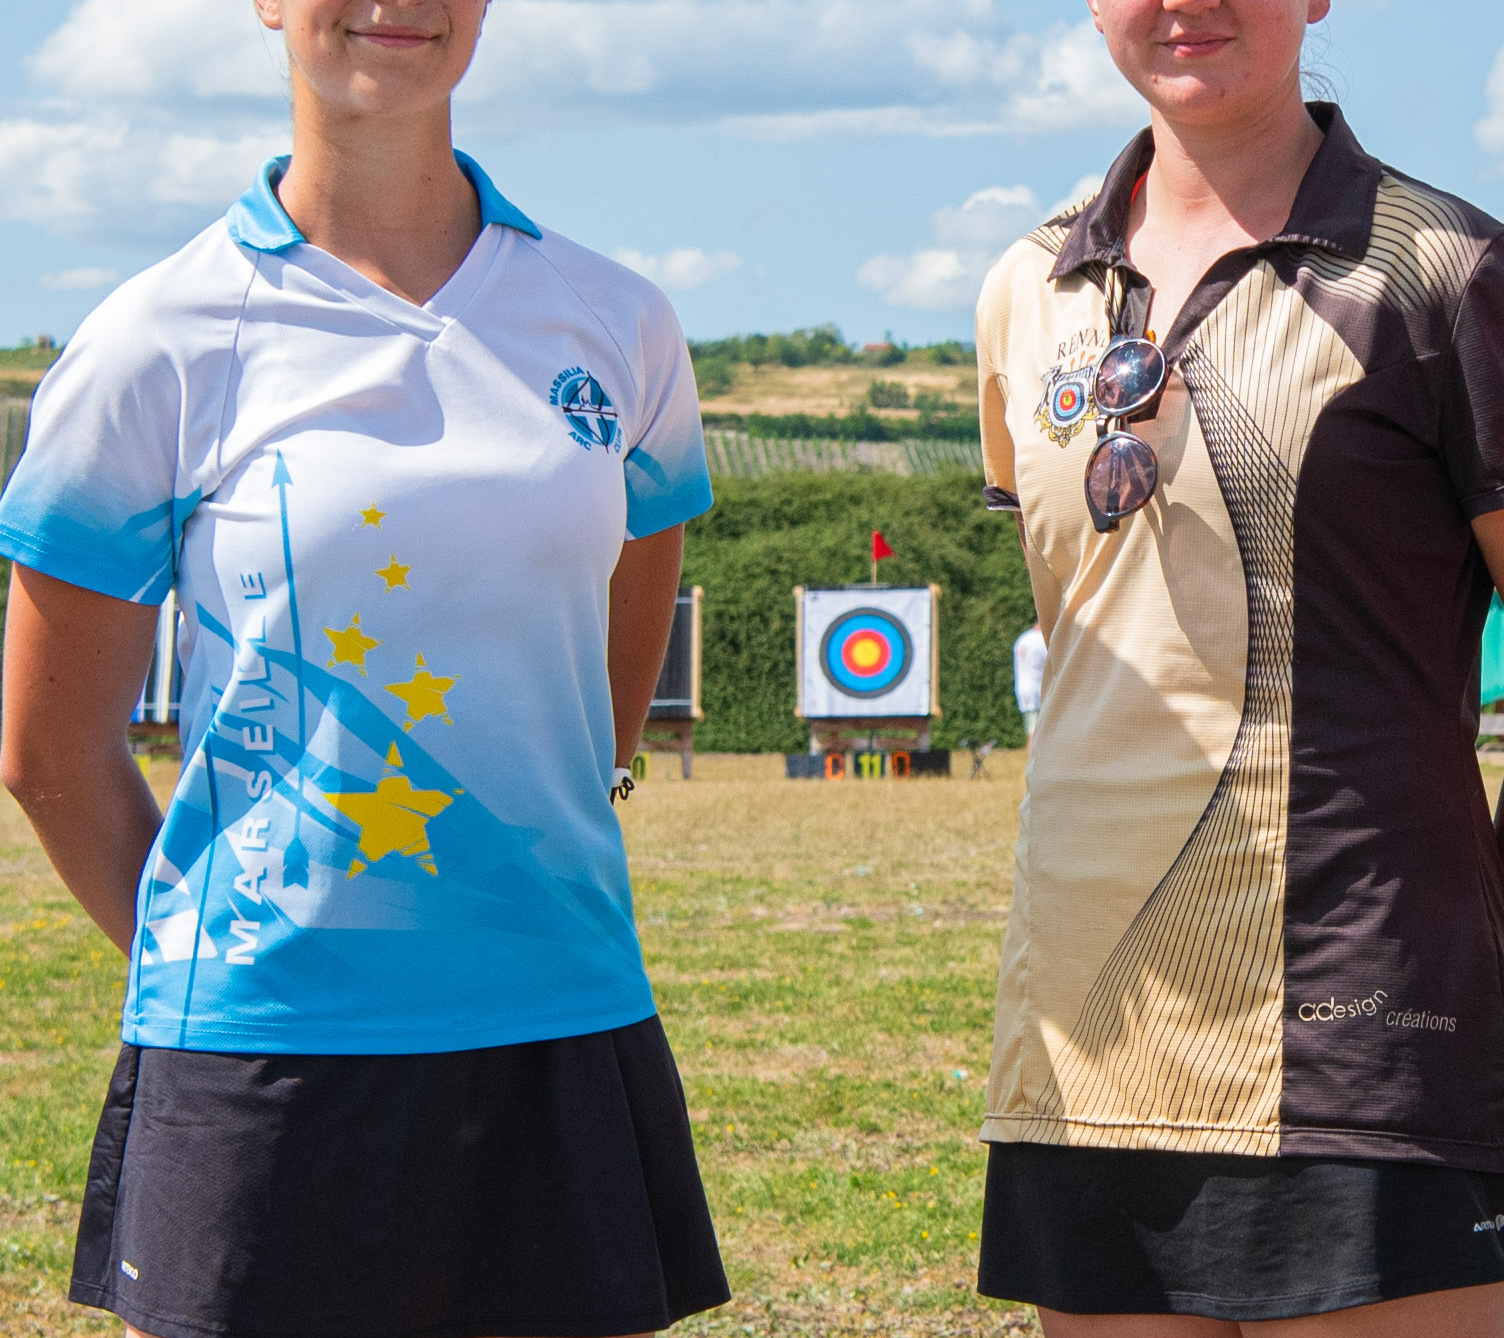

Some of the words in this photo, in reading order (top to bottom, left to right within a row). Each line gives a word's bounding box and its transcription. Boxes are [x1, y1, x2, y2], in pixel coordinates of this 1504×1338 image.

[568, 431, 591, 451] ARC
[857, 752, 883, 779] 11
[1298, 989, 1388, 1021] adesign
[1386, 1008, 1457, 1032] créations
